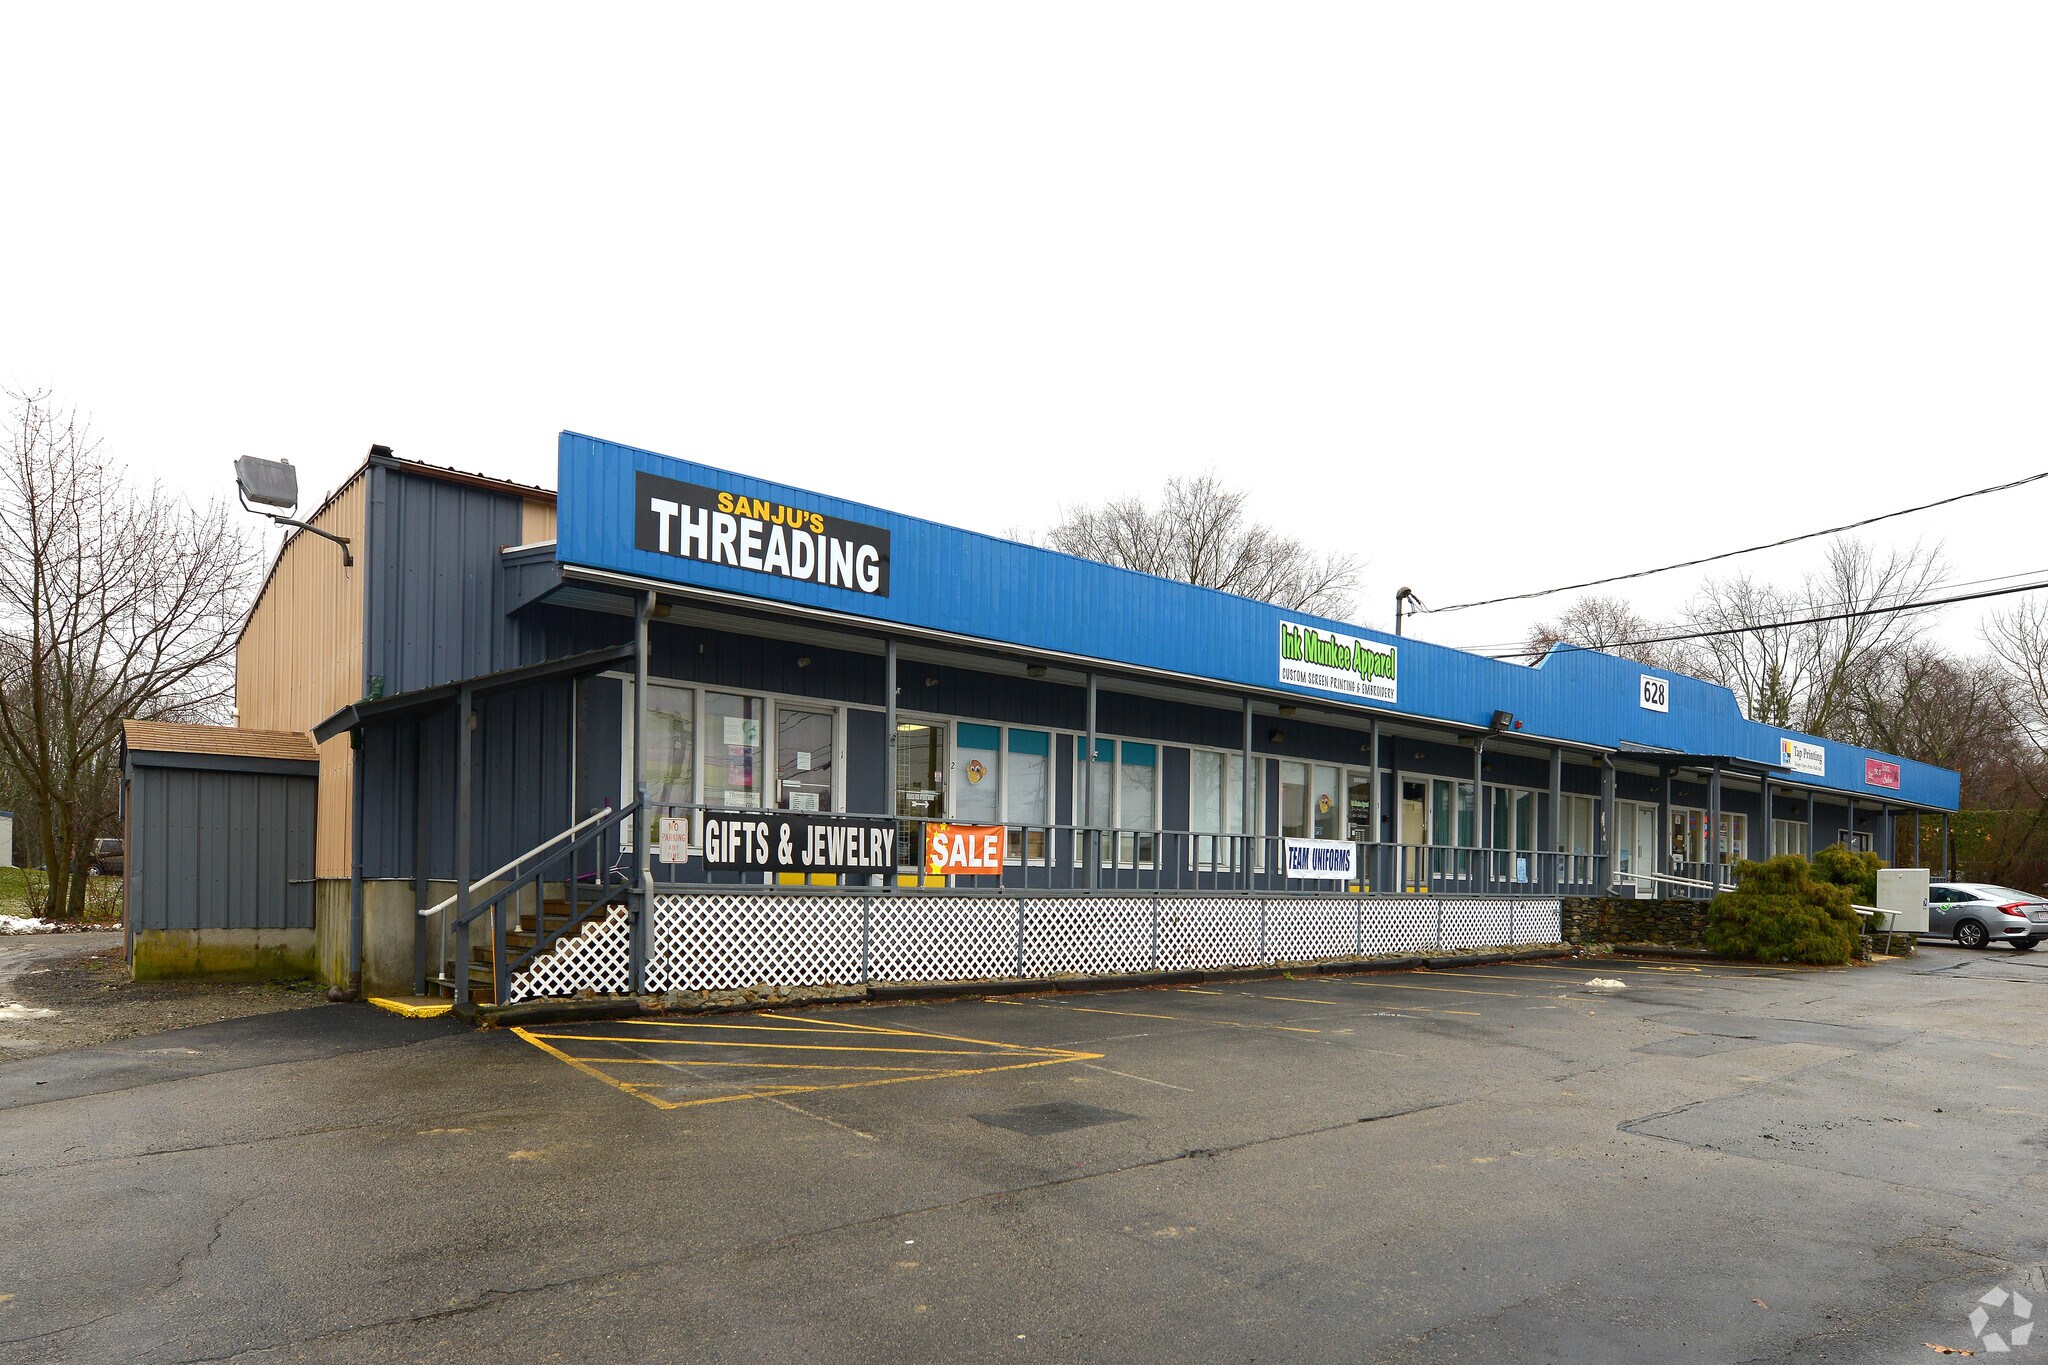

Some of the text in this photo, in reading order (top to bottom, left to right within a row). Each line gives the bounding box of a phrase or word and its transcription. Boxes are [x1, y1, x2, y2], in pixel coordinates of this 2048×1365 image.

[717, 491, 825, 534] SANJU'S
[650, 497, 880, 593] THREADING
[1281, 623, 1396, 682] Ink Munkee Apparel
[1282, 667, 1307, 683] CUSTOM
[1307, 672, 1329, 687] SCREEN
[1330, 676, 1356, 693] PRINTING
[1361, 683, 1395, 699] EMBROIDERY
[1644, 681, 1665, 706] 628
[1793, 745, 1823, 765] Tap Printing
[661, 833, 686, 842] PARKING
[668, 822, 679, 831] NO
[705, 819, 895, 867] GIFTS & JEWELRY
[931, 833, 999, 868] SALE
[1288, 846, 1351, 872] TEAM UNIFORMS
